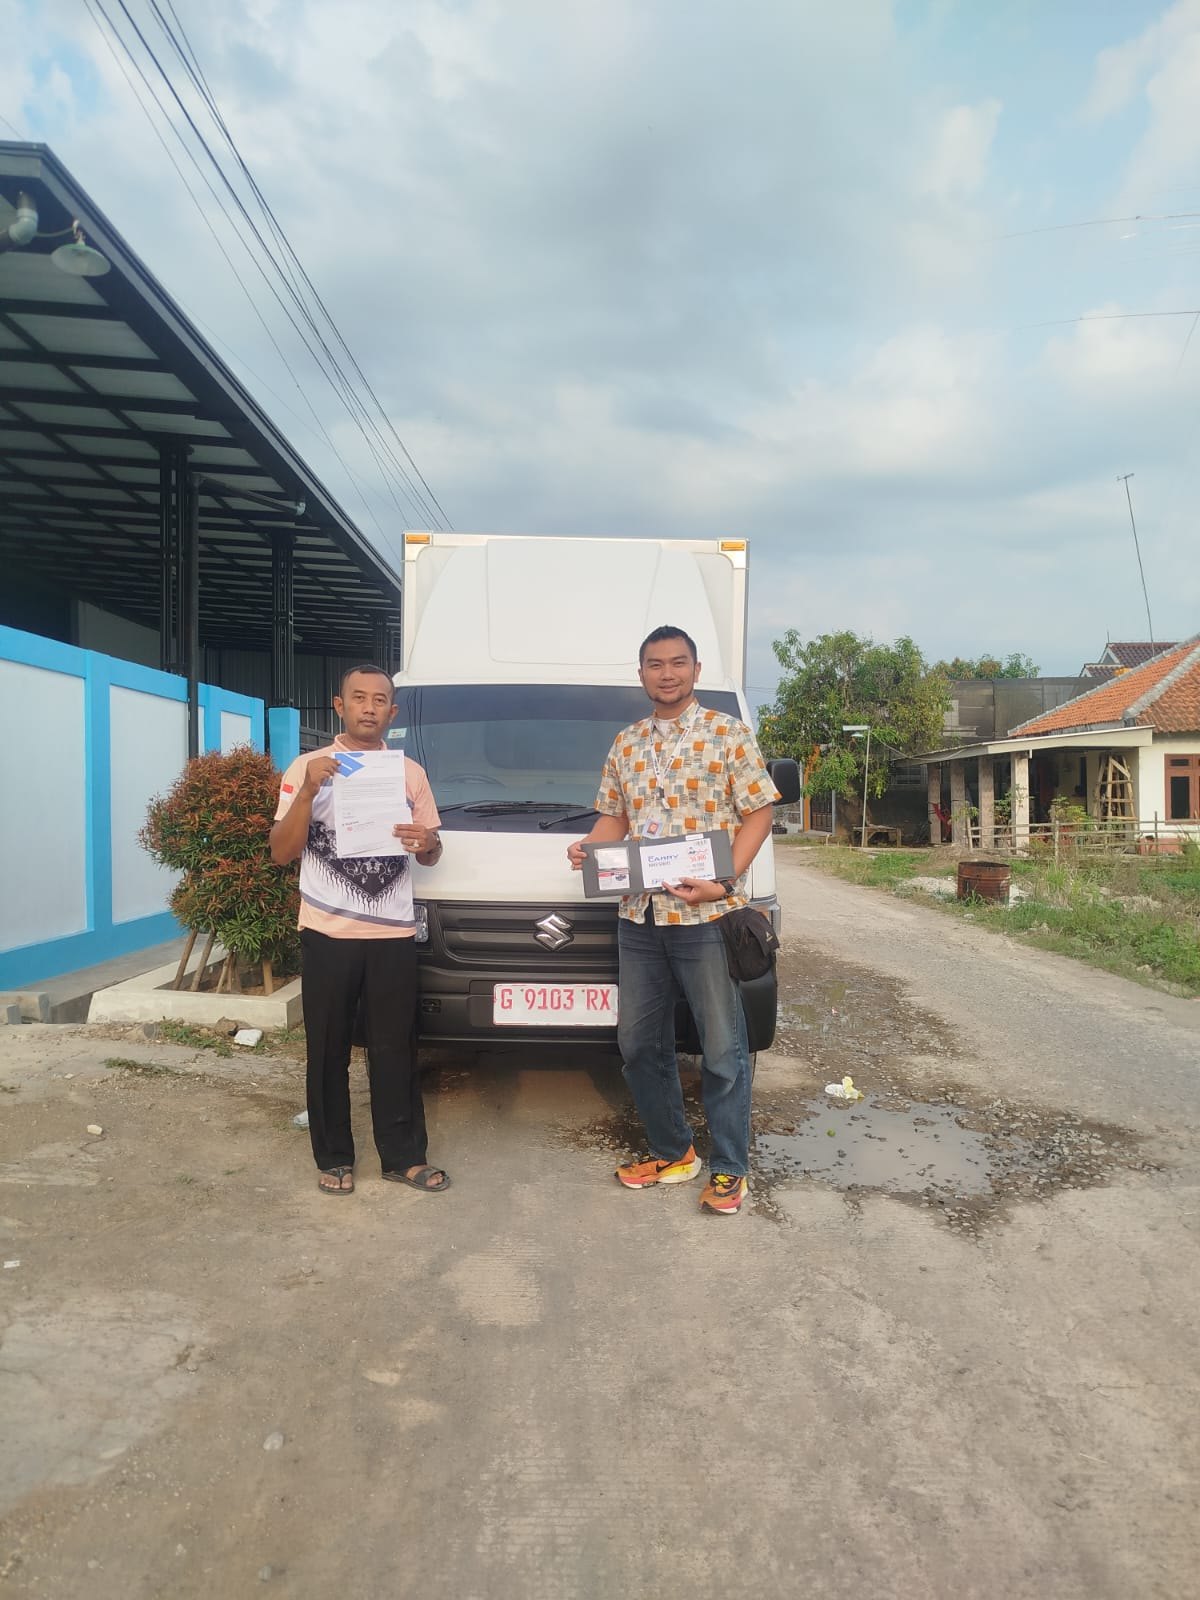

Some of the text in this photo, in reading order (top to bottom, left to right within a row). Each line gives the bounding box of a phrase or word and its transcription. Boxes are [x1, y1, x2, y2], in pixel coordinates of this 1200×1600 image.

[500, 988, 611, 1011] G 9103 RX
